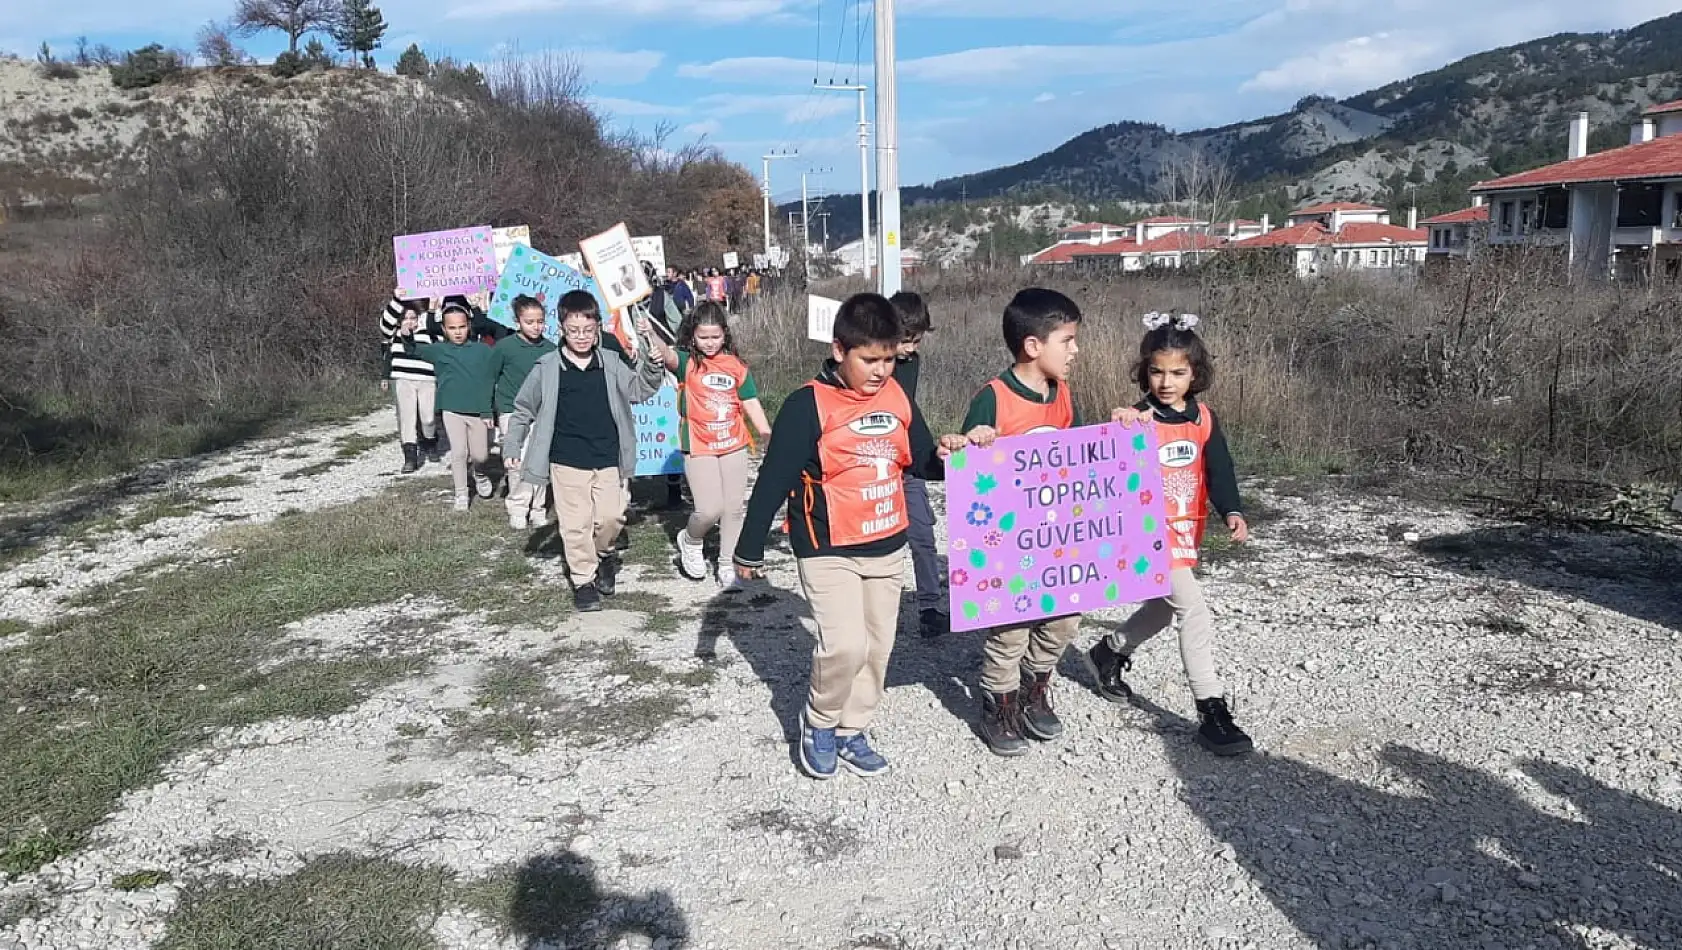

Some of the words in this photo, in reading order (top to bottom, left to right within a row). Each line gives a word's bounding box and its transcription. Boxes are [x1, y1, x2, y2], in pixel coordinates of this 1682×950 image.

[540, 261, 591, 290] TOPRAK
[1014, 438, 1116, 472] SAĞLIKLI
[1023, 476, 1123, 509] TOPRAK,
[1017, 510, 1123, 550] GÜVENLİ
[1041, 562, 1108, 588] GIDA.
